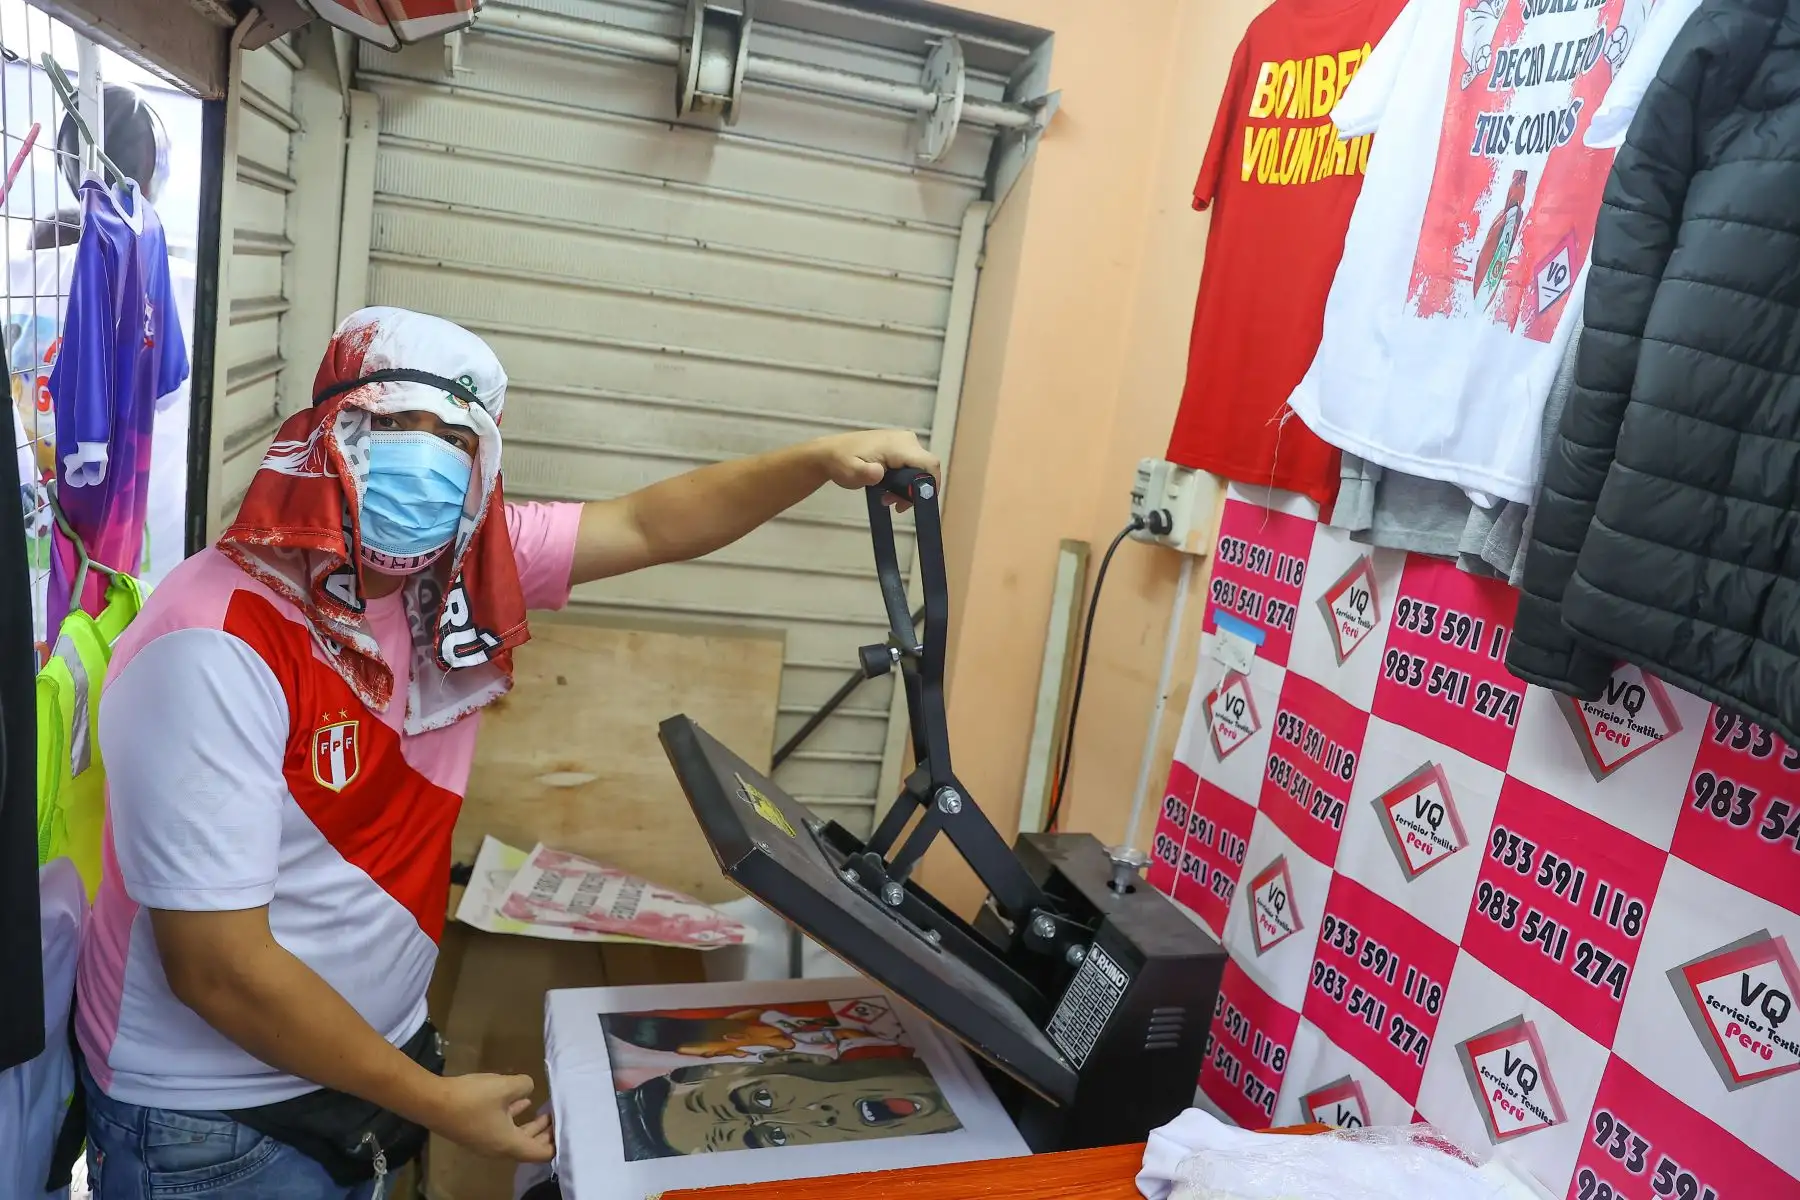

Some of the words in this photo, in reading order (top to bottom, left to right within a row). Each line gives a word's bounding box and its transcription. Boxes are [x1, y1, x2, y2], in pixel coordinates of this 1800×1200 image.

[1249, 42, 1372, 119] BOMBE
[1489, 44, 1545, 88] PECHO
[1472, 114, 1514, 155] TUS
[1515, 100, 1583, 155] COLOS
[1547, 262, 1567, 287] VQ
[1220, 538, 1246, 565] 933
[1247, 546, 1272, 575] 591
[1277, 556, 1304, 585] 118
[1213, 580, 1238, 607] 983
[1237, 589, 1263, 618] 541
[1266, 600, 1295, 631] 274
[1350, 586, 1369, 616] VQ
[1398, 599, 1437, 634] 933
[1440, 612, 1483, 650] 591
[1226, 692, 1245, 720] VQ
[1386, 650, 1425, 687] 983
[1428, 666, 1469, 704] 541
[1474, 683, 1520, 726] 274
[1607, 677, 1645, 718] VQ
[321, 737, 352, 755] FPF
[1278, 712, 1302, 744] 933
[1303, 729, 1325, 761] 591
[1325, 743, 1355, 780] 118
[1583, 702, 1624, 725] Servicios
[1627, 719, 1664, 741] Textiles
[1594, 722, 1630, 747] Perú
[1715, 708, 1772, 757] 933
[1269, 756, 1291, 788] 983
[1290, 775, 1311, 807] 541
[1311, 790, 1344, 828] 274
[1416, 794, 1444, 831] VQ
[1695, 773, 1757, 826] 983
[1761, 801, 1800, 851] 54
[1166, 797, 1187, 827] 933
[1188, 813, 1214, 845] 591
[1220, 832, 1245, 864] 118
[1396, 814, 1428, 836] Servicios
[1407, 832, 1433, 855] Perú
[1157, 835, 1179, 865] 983
[1181, 853, 1207, 884] 541
[1212, 871, 1235, 902] 274
[1492, 828, 1535, 873] 933
[1537, 854, 1584, 903] 591
[1592, 883, 1644, 937] 118
[1269, 882, 1286, 914] VQ
[1323, 916, 1358, 955] 933
[1361, 940, 1398, 983] 591
[1405, 969, 1441, 1014] 118
[1478, 883, 1520, 929] 983
[1521, 910, 1568, 961] 541
[1574, 942, 1628, 999] 274
[1096, 955, 1125, 987] RHINO
[1313, 961, 1347, 1001] 983
[1349, 987, 1386, 1031] 541
[1391, 1017, 1429, 1065] 274
[1706, 995, 1763, 1032] Servicios
[1768, 1028, 1800, 1057] Texti
[1741, 973, 1791, 1028] VQ
[1224, 1005, 1248, 1044] 591
[1253, 1032, 1286, 1072] 118
[1725, 1022, 1773, 1060] Perú
[1215, 1046, 1240, 1084] 541
[1245, 1073, 1275, 1115] 274
[1480, 1066, 1518, 1098] Servicios
[1521, 1095, 1553, 1126] Textiles
[1504, 1049, 1538, 1096] VQ
[1493, 1089, 1525, 1121] Perú
[1595, 1112, 1649, 1173] 933
[1579, 1169, 1624, 1200] 98
